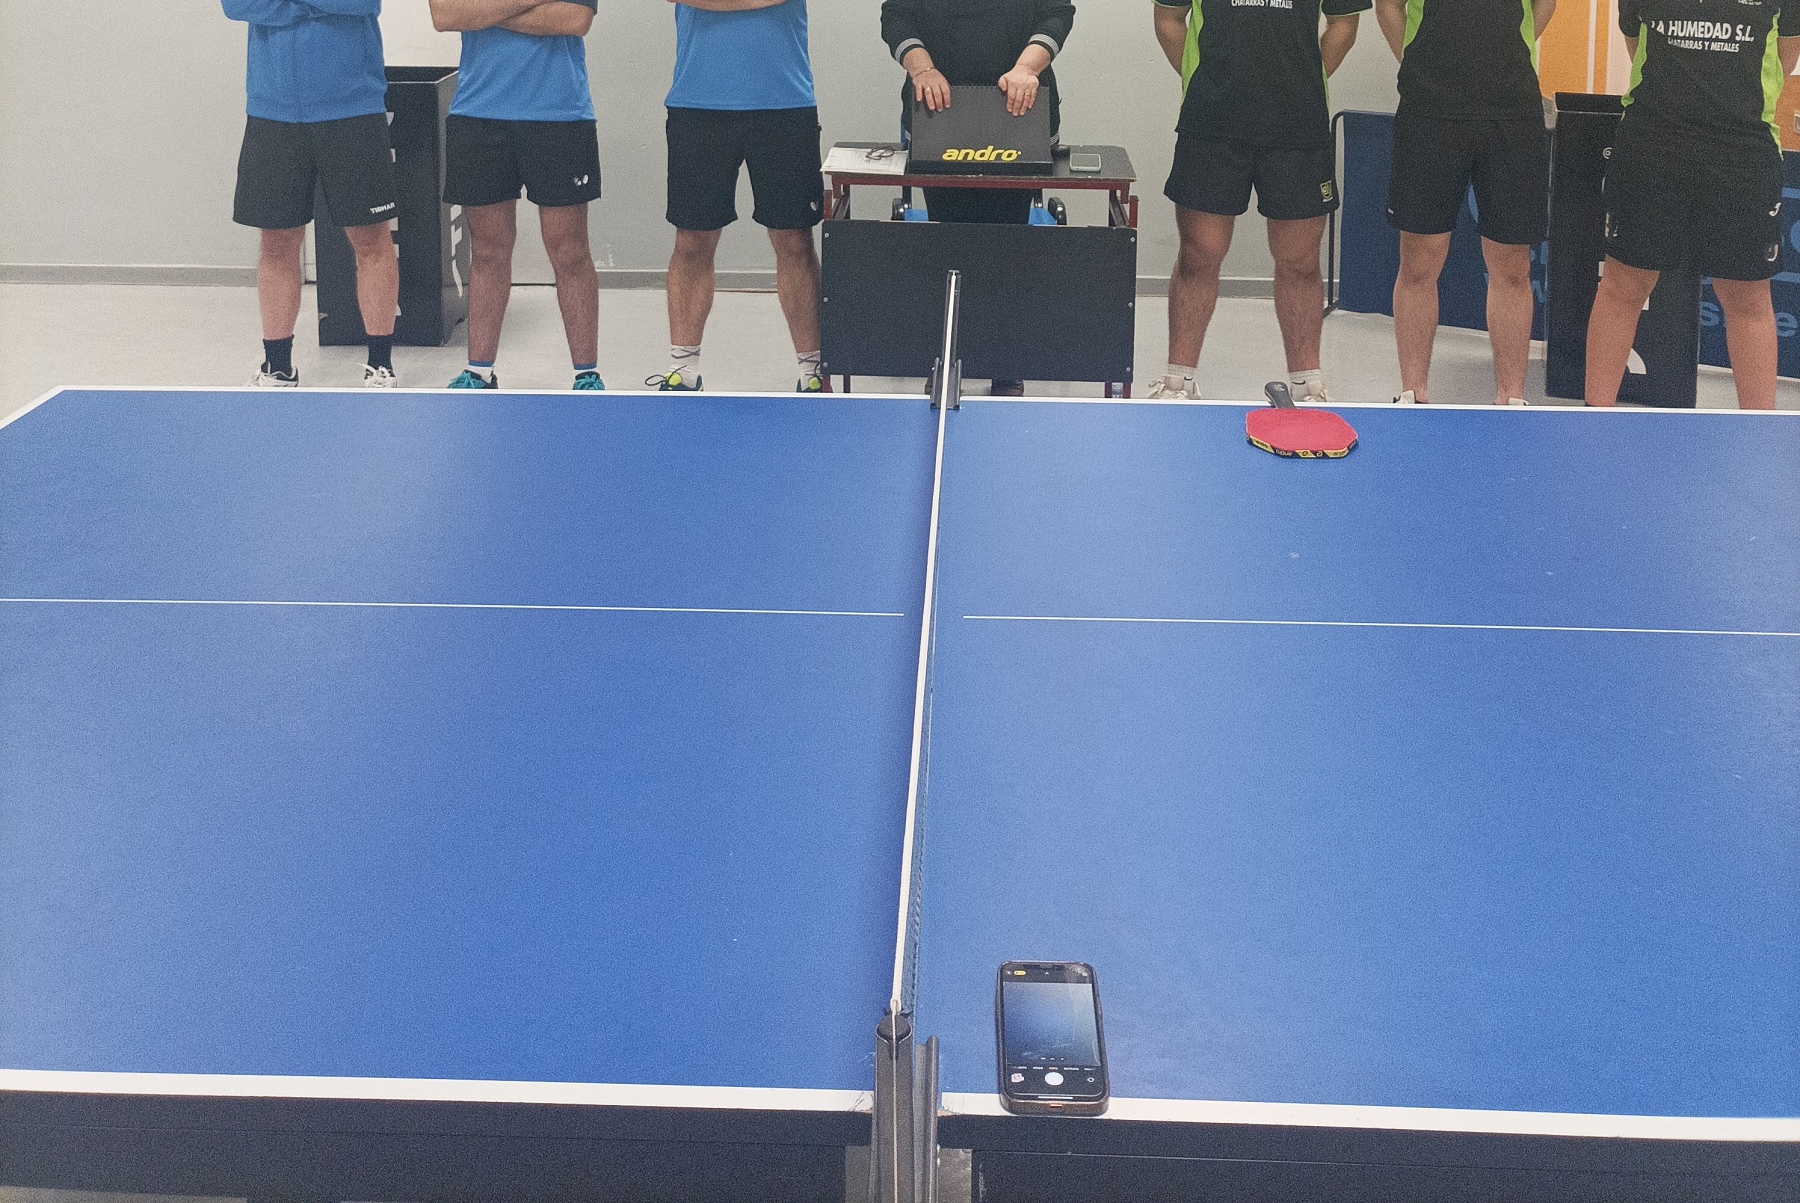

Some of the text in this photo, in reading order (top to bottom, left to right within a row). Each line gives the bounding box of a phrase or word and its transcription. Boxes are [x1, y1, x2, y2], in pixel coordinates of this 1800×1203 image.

[1270, 0, 1293, 9] METALES
[1667, 20, 1732, 40] HUMEDAD
[1704, 41, 1710, 50] Y
[1710, 41, 1740, 53] METALES
[942, 145, 1022, 162] andro
